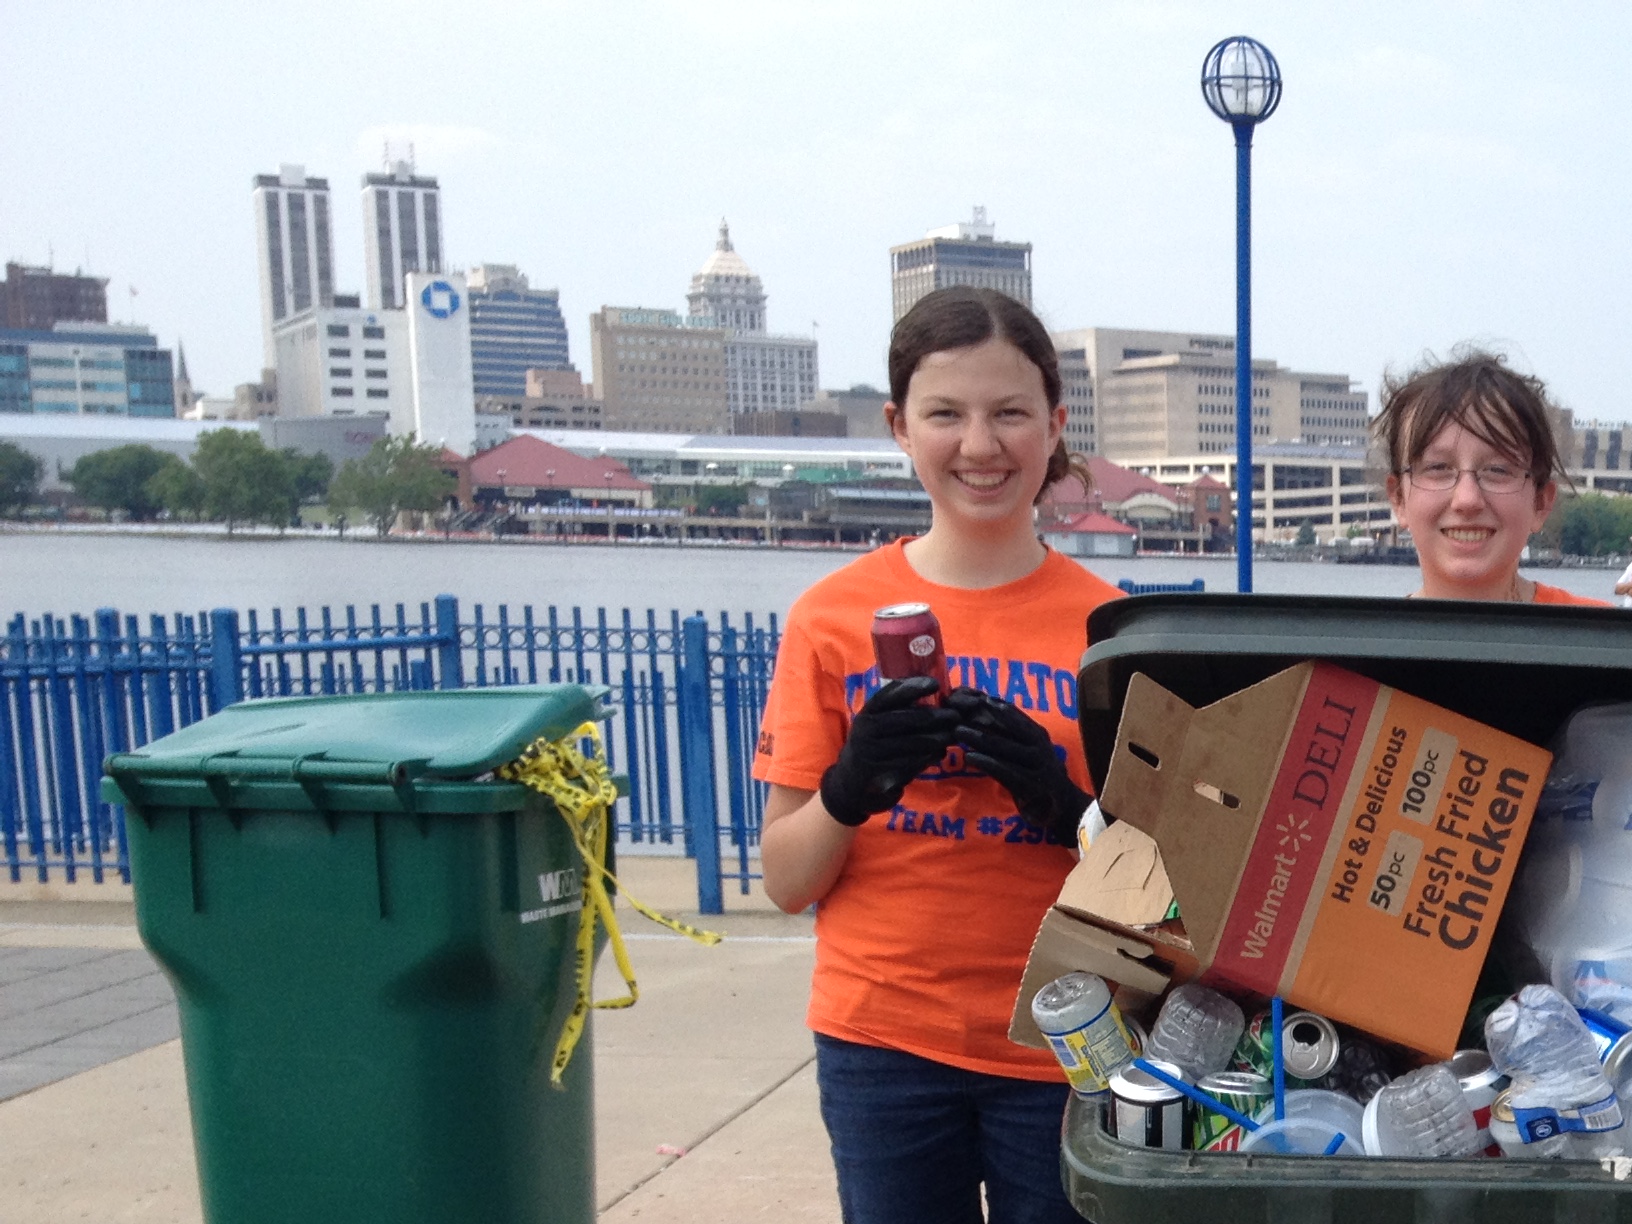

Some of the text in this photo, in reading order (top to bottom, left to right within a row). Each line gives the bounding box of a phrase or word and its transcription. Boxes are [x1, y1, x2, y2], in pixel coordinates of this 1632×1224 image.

[1240, 696, 1357, 961] Walmart DELI
[1331, 725, 1408, 904] Hot & Delicious
[1403, 747, 1490, 939] Fresh Fried
[1438, 765, 1531, 953] Chicken
